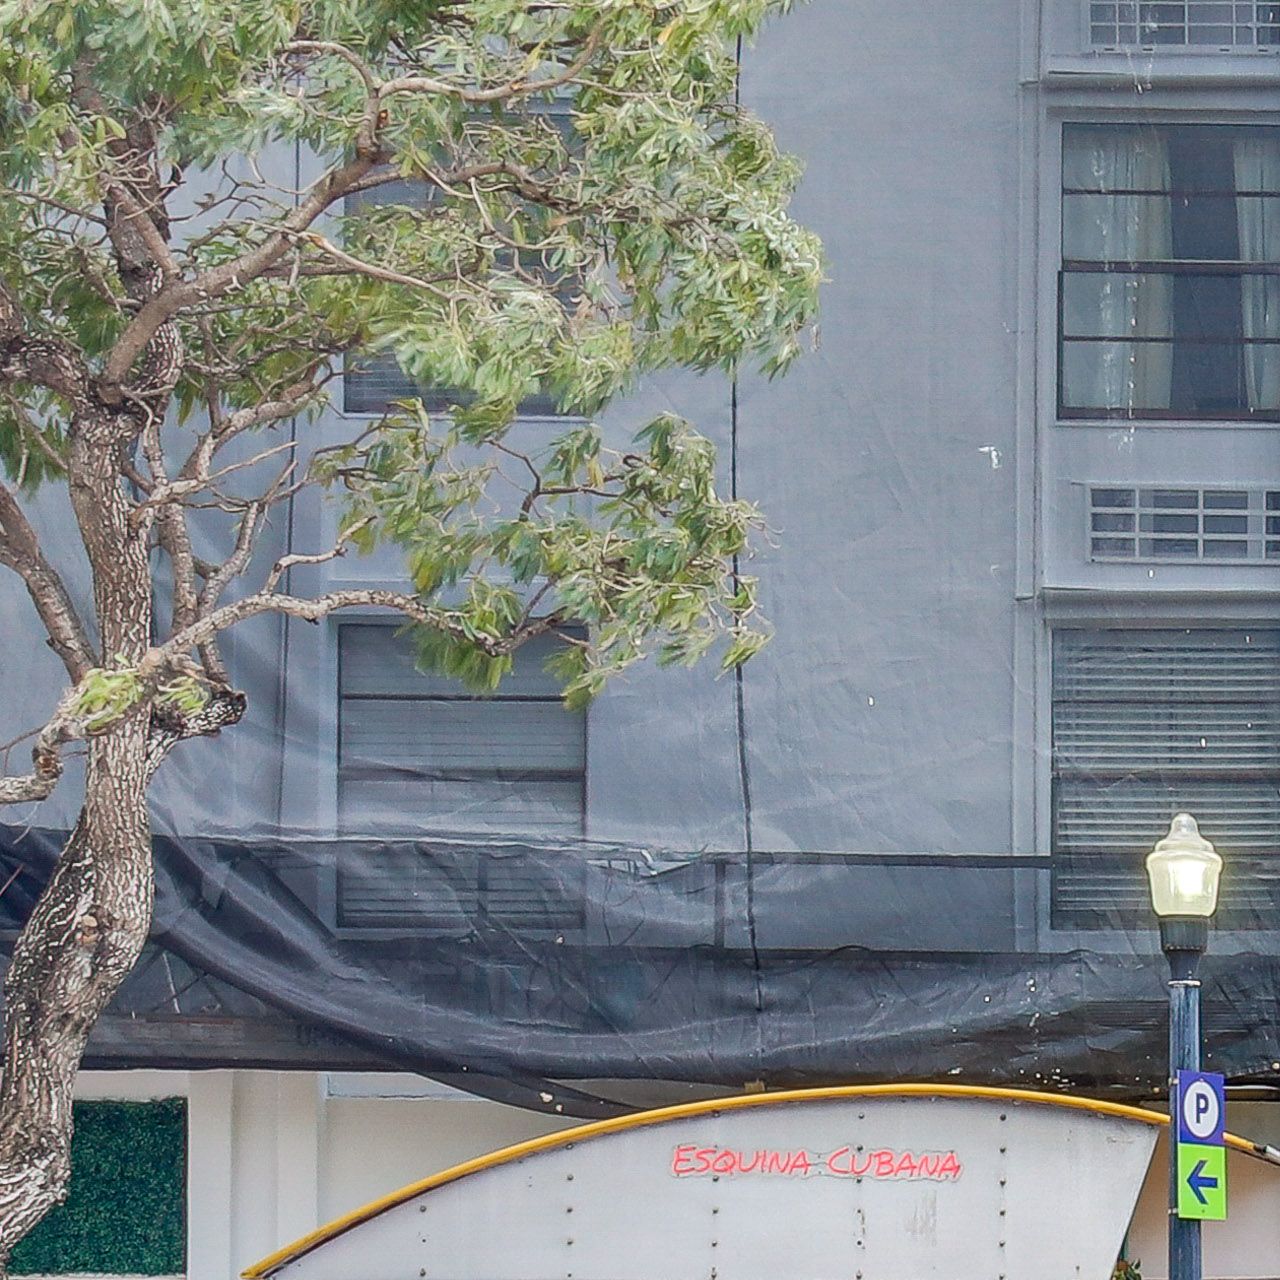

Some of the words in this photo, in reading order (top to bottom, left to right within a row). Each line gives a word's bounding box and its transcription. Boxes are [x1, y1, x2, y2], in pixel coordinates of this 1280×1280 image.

[1195, 1092, 1210, 1124] P
[671, 1146, 811, 1176] ESQUINA
[827, 1147, 961, 1178] CUBANA
